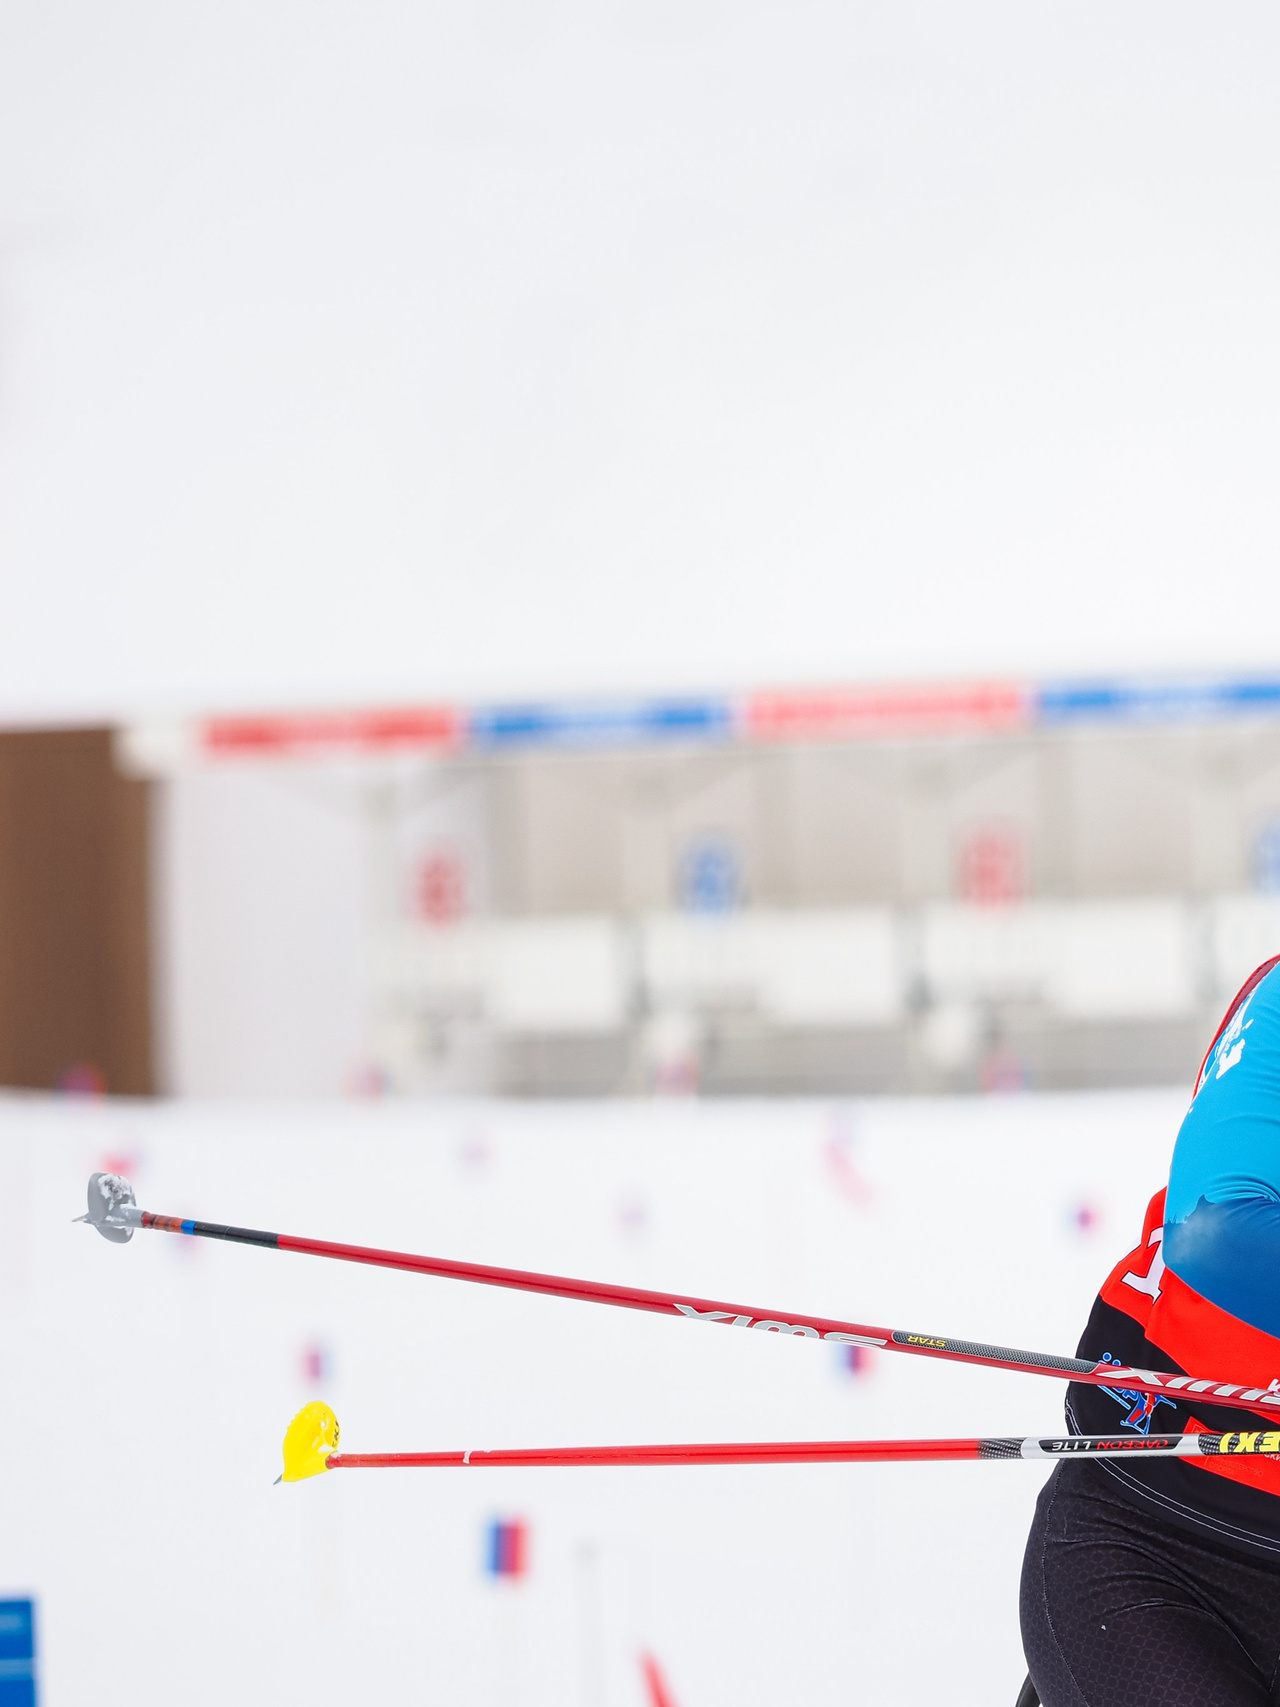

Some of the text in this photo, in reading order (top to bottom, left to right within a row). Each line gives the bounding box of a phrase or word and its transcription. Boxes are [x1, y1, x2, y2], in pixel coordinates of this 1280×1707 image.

[907, 1334, 947, 1348] STAR
[1051, 1438, 1169, 1451] CARBON LITE
